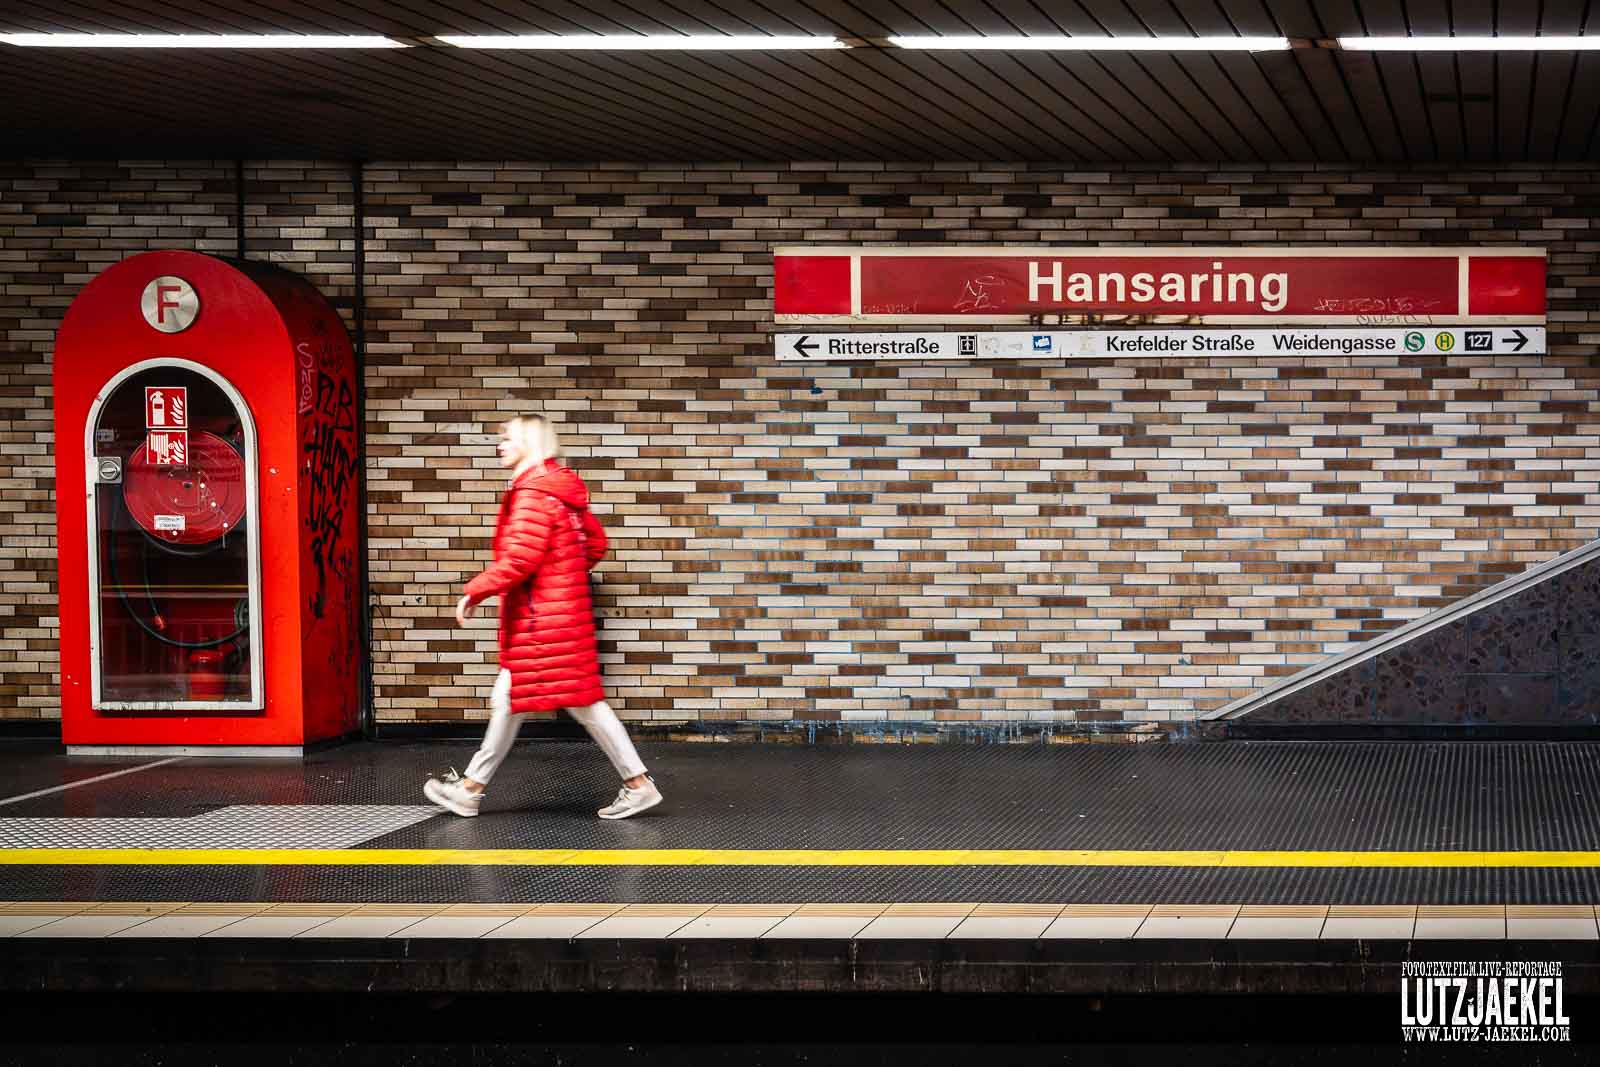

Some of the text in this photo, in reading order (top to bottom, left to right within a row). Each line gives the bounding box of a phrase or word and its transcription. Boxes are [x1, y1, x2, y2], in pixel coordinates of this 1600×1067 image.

[1028, 261, 1289, 312] Hansaring
[156, 285, 181, 323] F
[828, 337, 940, 355] Ritterstraße
[1106, 334, 1255, 352] Krefelder Straße
[1272, 334, 1396, 353] Weidengasse
[1406, 333, 1424, 350] S
[1467, 334, 1491, 349] 127
